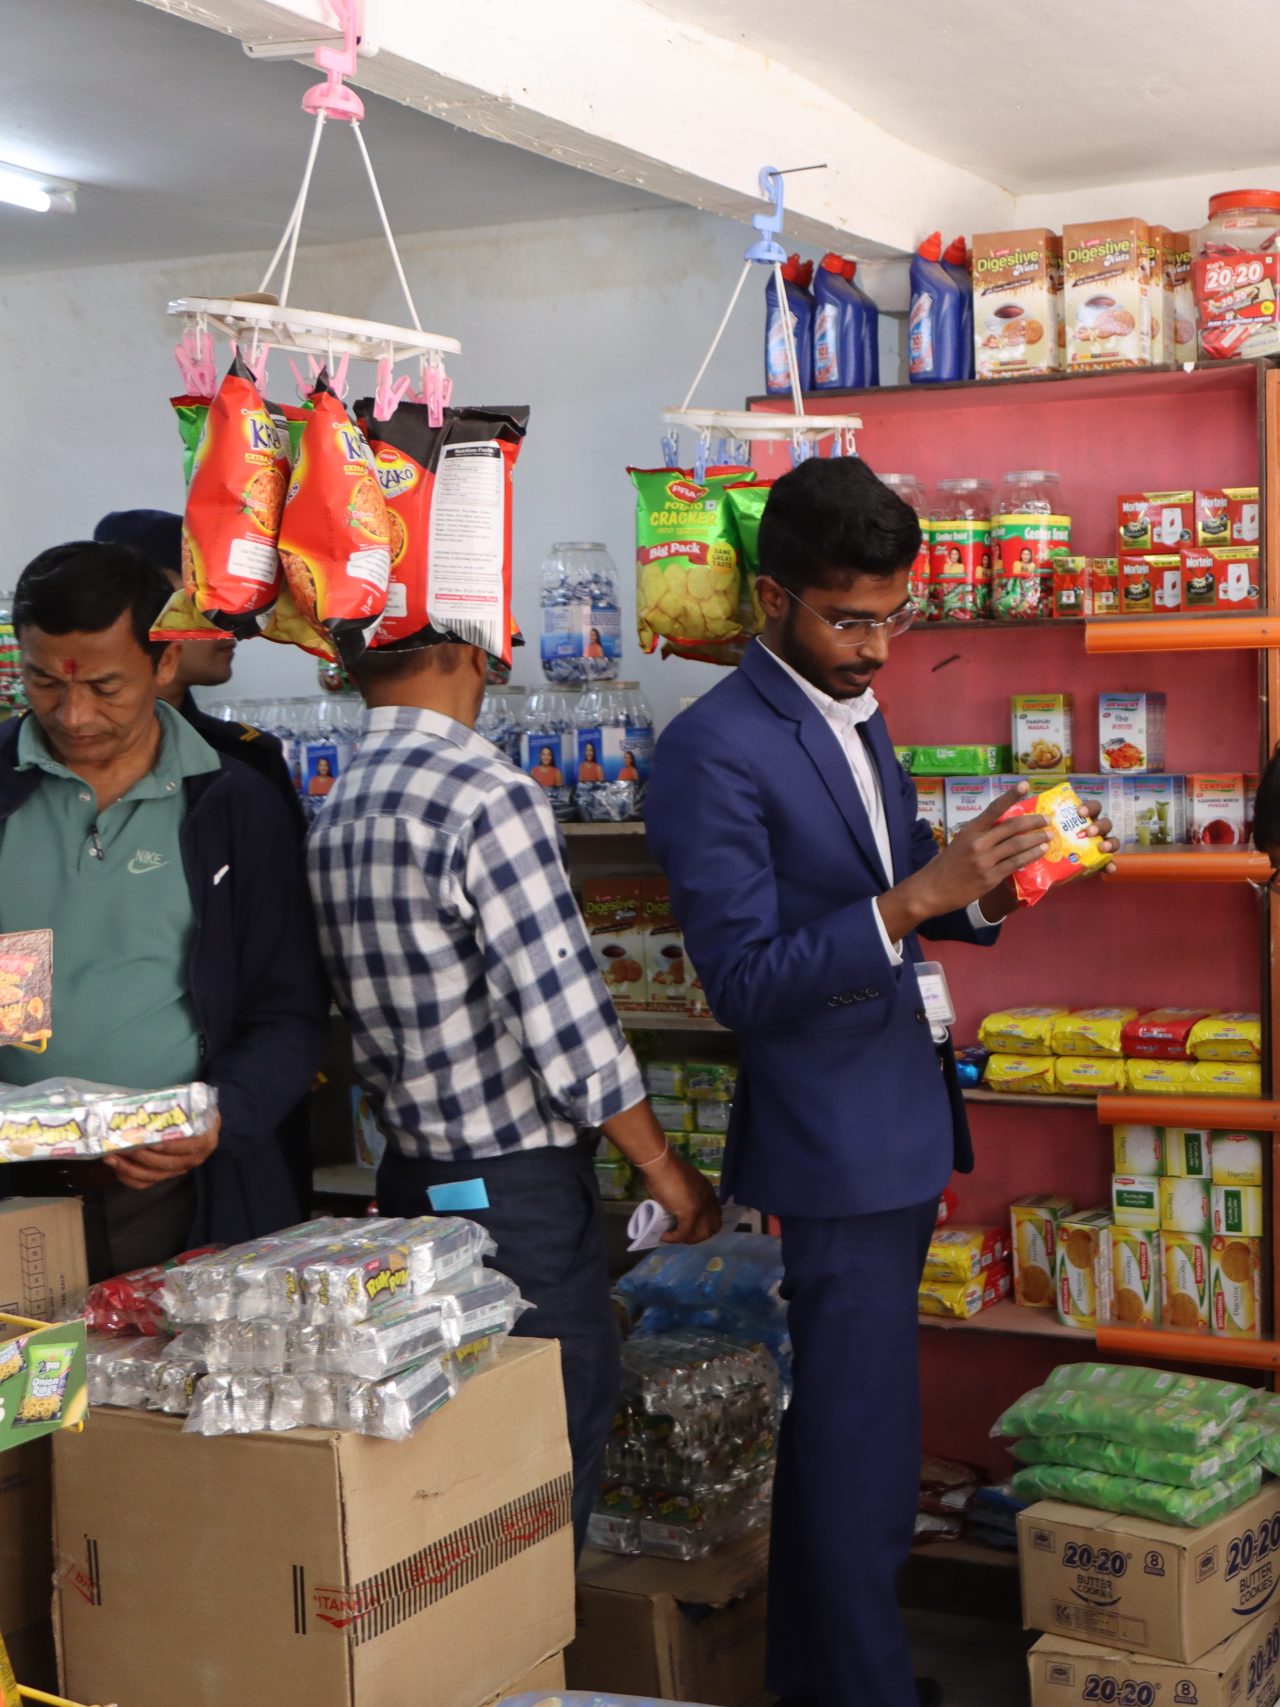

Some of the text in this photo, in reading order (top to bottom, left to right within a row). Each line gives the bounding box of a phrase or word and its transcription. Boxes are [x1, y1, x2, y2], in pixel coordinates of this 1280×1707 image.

[1068, 240, 1130, 262] Digestive
[977, 250, 1039, 272] Digestive
[1103, 253, 1130, 267] Nuts
[1012, 264, 1039, 276] Nuts
[1205, 261, 1263, 290] 20-20
[1123, 502, 1148, 513] Mortein
[1201, 498, 1227, 508] Mortein
[650, 511, 717, 526] CRACKER
[649, 542, 700, 559] Big Pack
[1124, 564, 1149, 575] Mortein
[1186, 557, 1213, 568] Mortein
[136, 849, 162, 864] NIKE
[32, 1377, 59, 1386] Onion
[32, 1385, 58, 1397] Rings
[1063, 1542, 1128, 1577] 20-20
[1150, 1554, 1159, 1567] 8
[1077, 1575, 1112, 1590] BUTTER
[1240, 1562, 1273, 1593] BUTTER
[1077, 1584, 1114, 1599] COOKIES
[1240, 1575, 1274, 1606] COOKIES
[1083, 1675, 1155, 1707] 20-20
